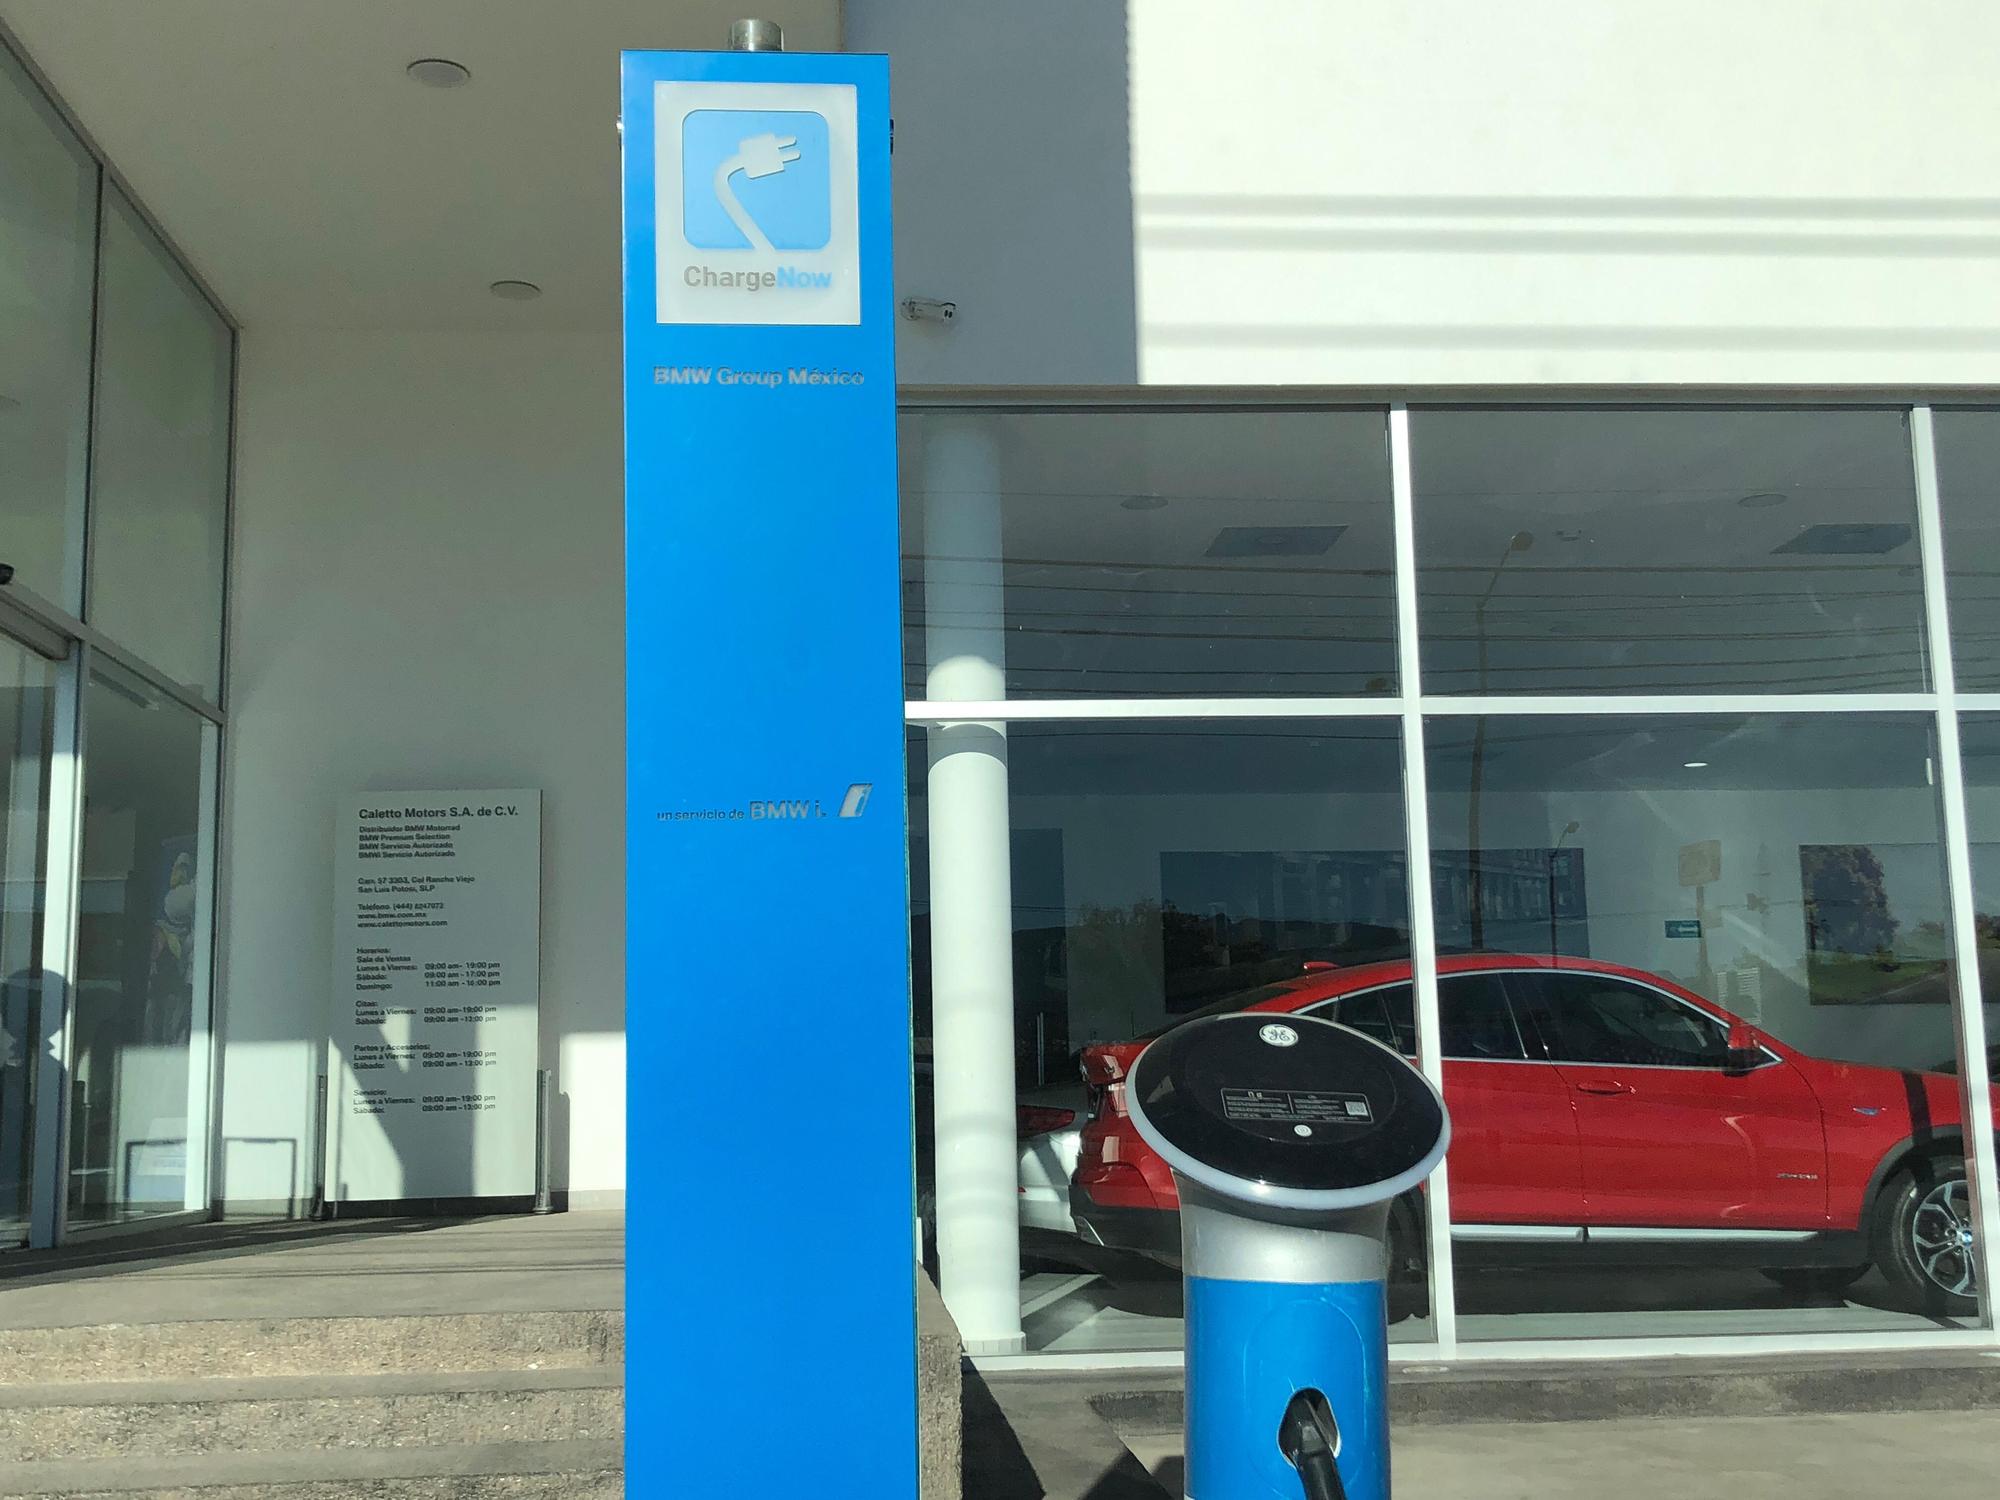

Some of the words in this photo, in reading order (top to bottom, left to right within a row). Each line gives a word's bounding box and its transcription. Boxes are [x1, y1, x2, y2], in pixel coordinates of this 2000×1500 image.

[683, 265, 832, 291] ChargeNow
[653, 366, 713, 385] BMW
[716, 367, 783, 388] Group
[788, 366, 864, 385] México
[359, 808, 401, 819] Caletto
[405, 807, 446, 818] Motors
[450, 806, 474, 817] S.A.
[477, 806, 492, 817] de
[494, 805, 518, 816] C.V.
[657, 811, 673, 820] un
[675, 808, 726, 820] servicio
[728, 808, 744, 820] de
[750, 800, 809, 819] BMW
[359, 825, 402, 833] Distribuidor
[405, 824, 424, 832] BMW
[426, 824, 460, 832] Motorrad
[359, 834, 379, 842] BMW
[381, 842, 411, 850] Servicio
[412, 841, 453, 849] Autorizado
[414, 850, 455, 858] Autorizado
[426, 875, 454, 883] Rancho
[456, 875, 475, 884] Viejo
[374, 885, 390, 893] Luis
[419, 884, 435, 892] SLP
[357, 919, 448, 928] www.calettomotors.com
[375, 955, 384, 963] de
[386, 955, 411, 963] Ventas
[387, 963, 418, 971] Viernes:
[488, 962, 501, 970] pm
[425, 980, 447, 988] 11:00
[424, 1006, 446, 1014] 09:00
[485, 1006, 497, 1014] pm
[354, 1044, 378, 1052] Partes
[386, 1043, 430, 1051] Accesorios:
[354, 1053, 377, 1061] Lunes
[384, 1052, 416, 1060] Viernes:
[422, 1051, 444, 1059] 09:00
[354, 1098, 376, 1106] Lunes
[484, 1104, 496, 1112] pm
